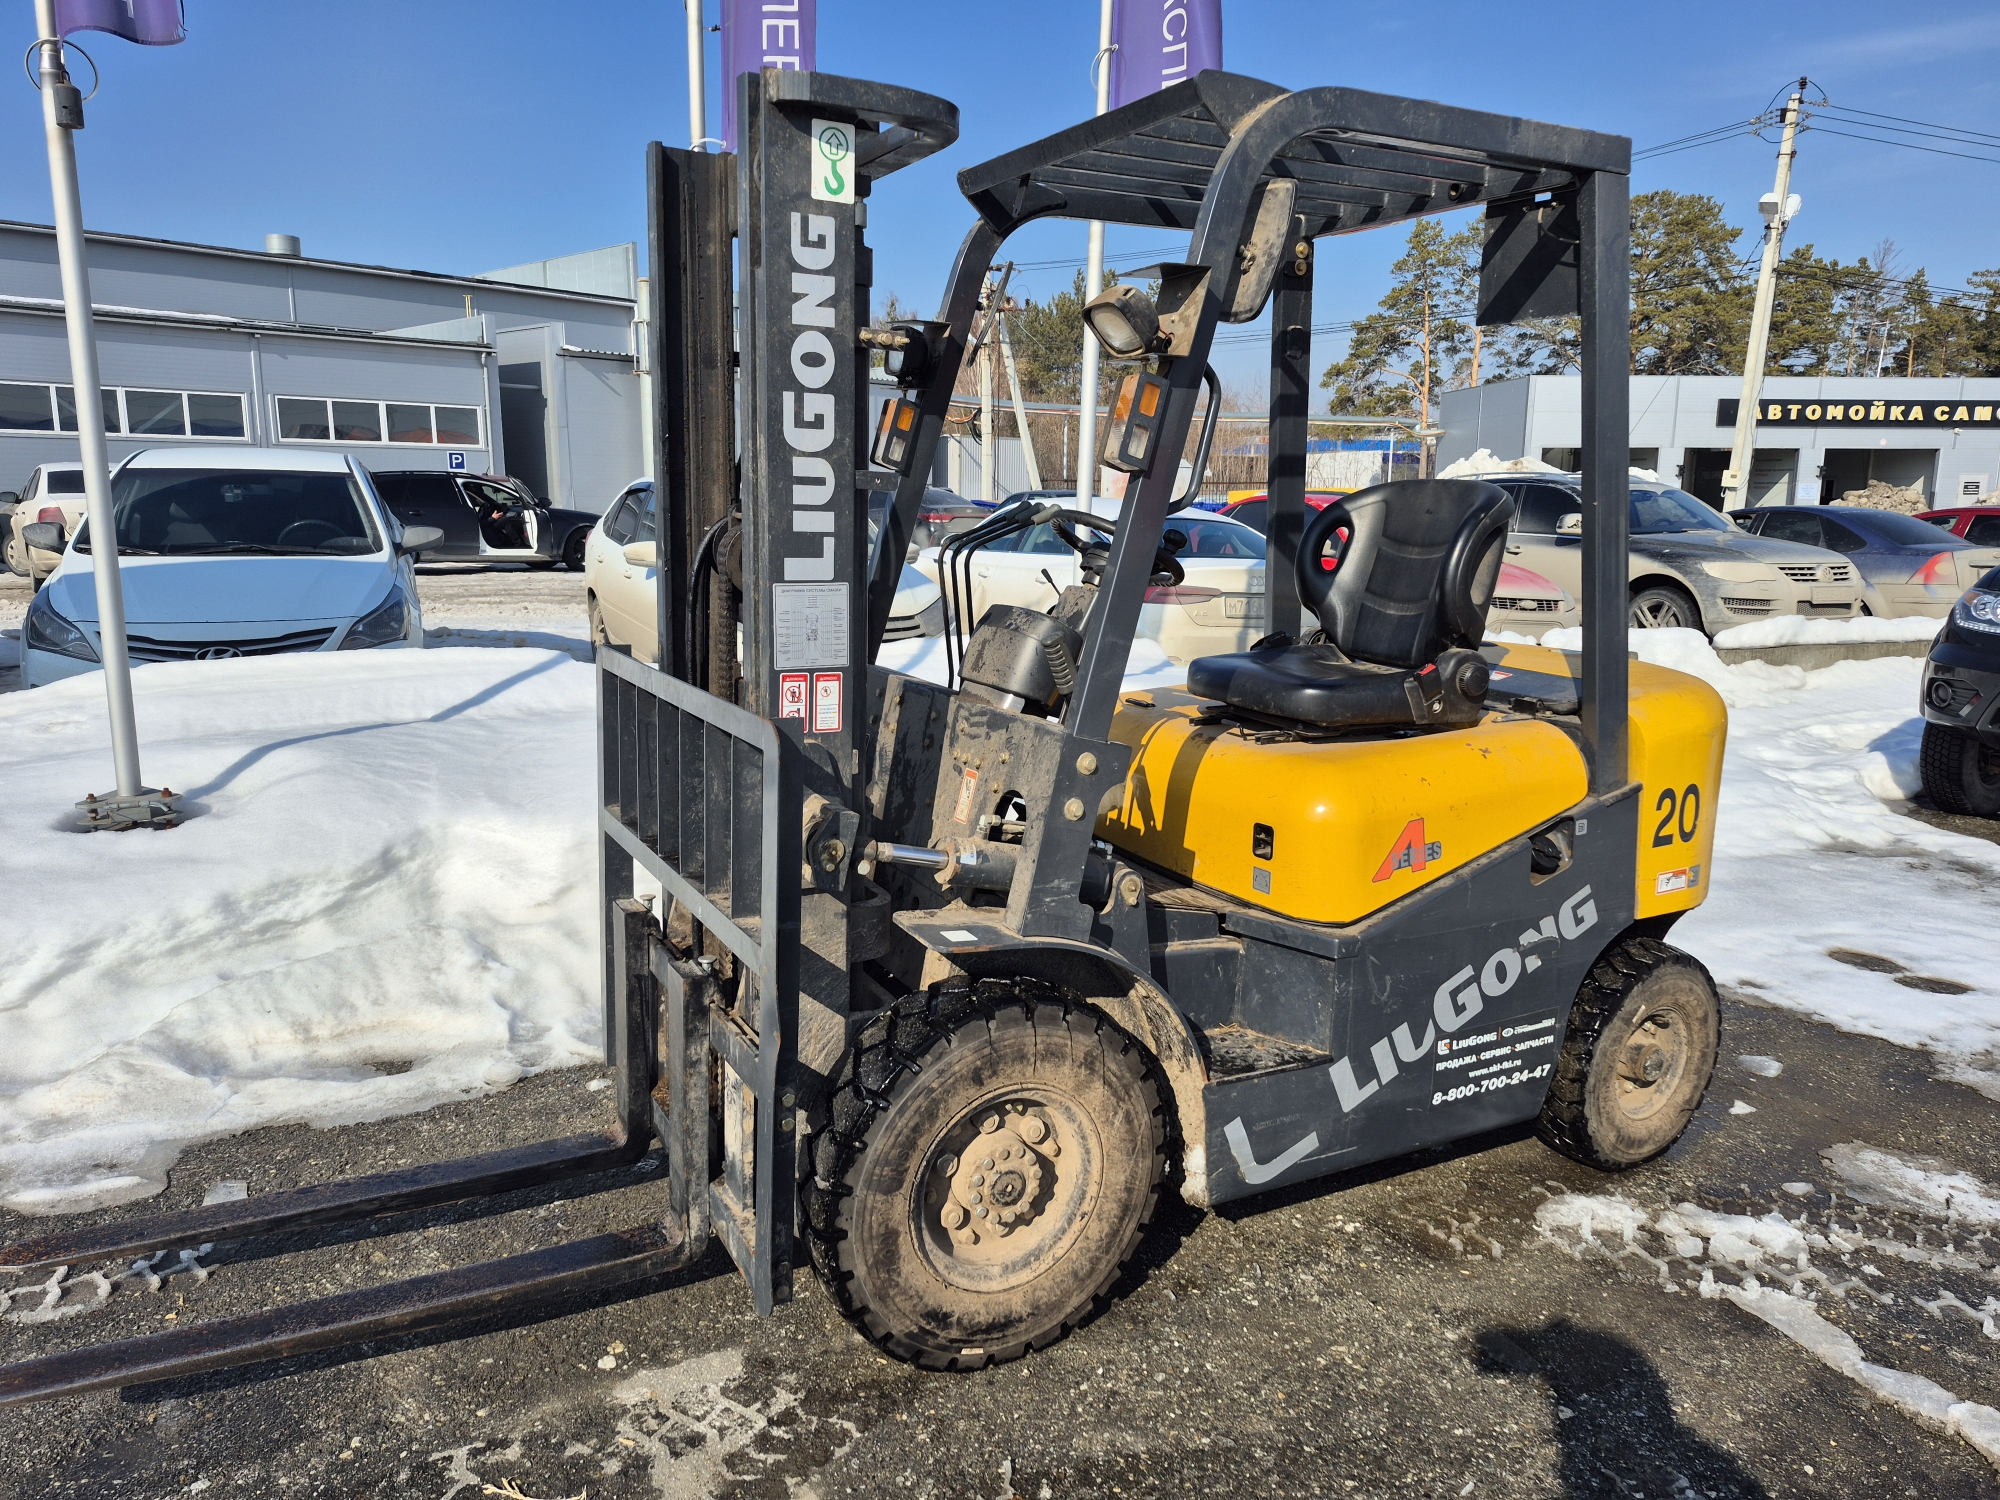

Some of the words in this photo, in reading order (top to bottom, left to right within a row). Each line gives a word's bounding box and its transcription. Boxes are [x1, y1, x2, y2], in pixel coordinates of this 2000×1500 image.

[1934, 405, 2000, 421] САМ
[1651, 783, 1700, 848] 20
[1391, 841, 1442, 871] SERIES
[1436, 1055, 1477, 1071] ПРОДАЖА
[1480, 1046, 1512, 1060] СЕРВИС
[1514, 1035, 1554, 1052] ЗАПЧАСТИ
[1432, 1063, 1551, 1105] 8-800-700-24-47
